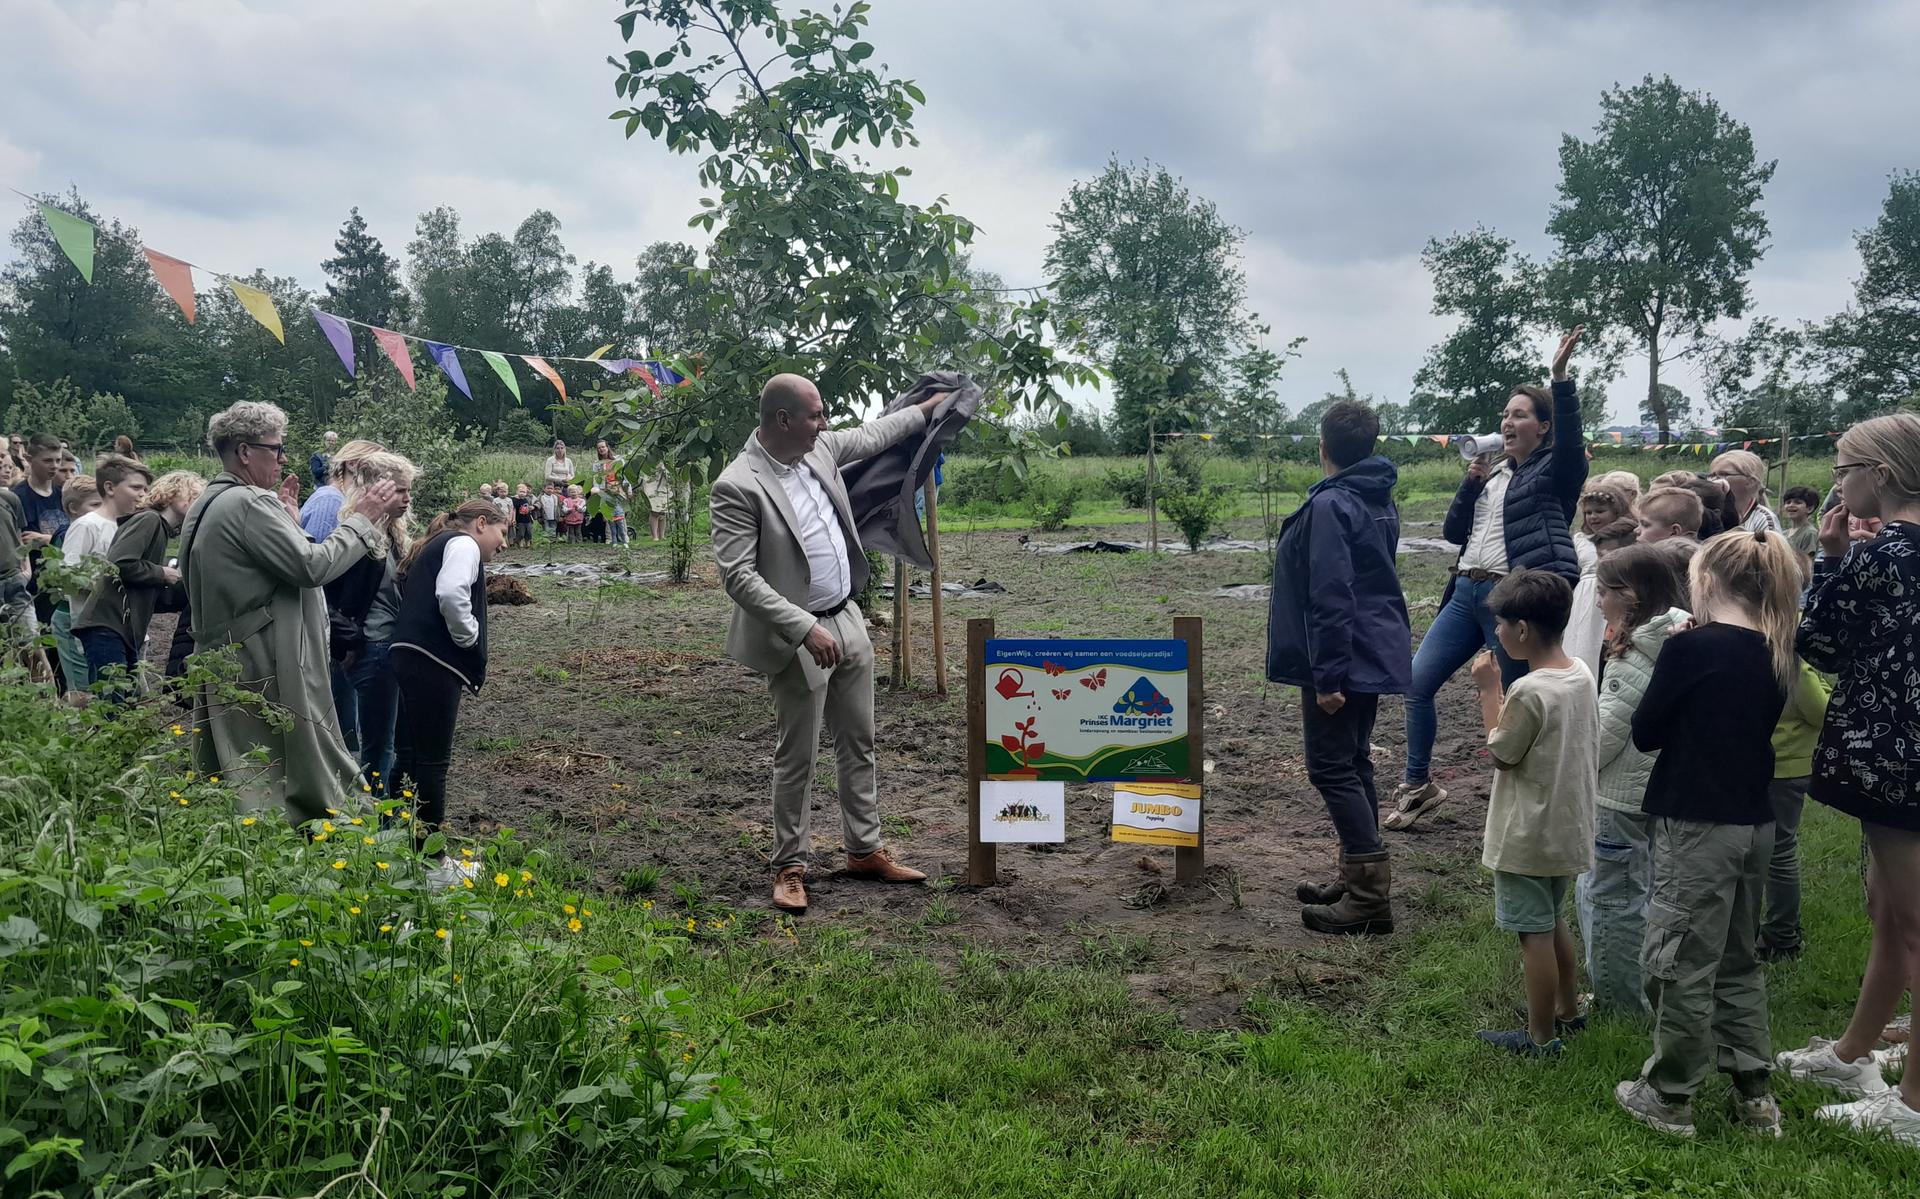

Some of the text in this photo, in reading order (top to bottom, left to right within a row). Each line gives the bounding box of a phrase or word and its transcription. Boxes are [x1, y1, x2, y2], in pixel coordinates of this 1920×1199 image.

[1853, 561, 1879, 590] LOVE
[1063, 650, 1074, 658] wij
[1115, 650, 1174, 659] voedselparadijs!
[1110, 715, 1173, 729] Margriet
[1130, 802, 1182, 817] JUMBO
